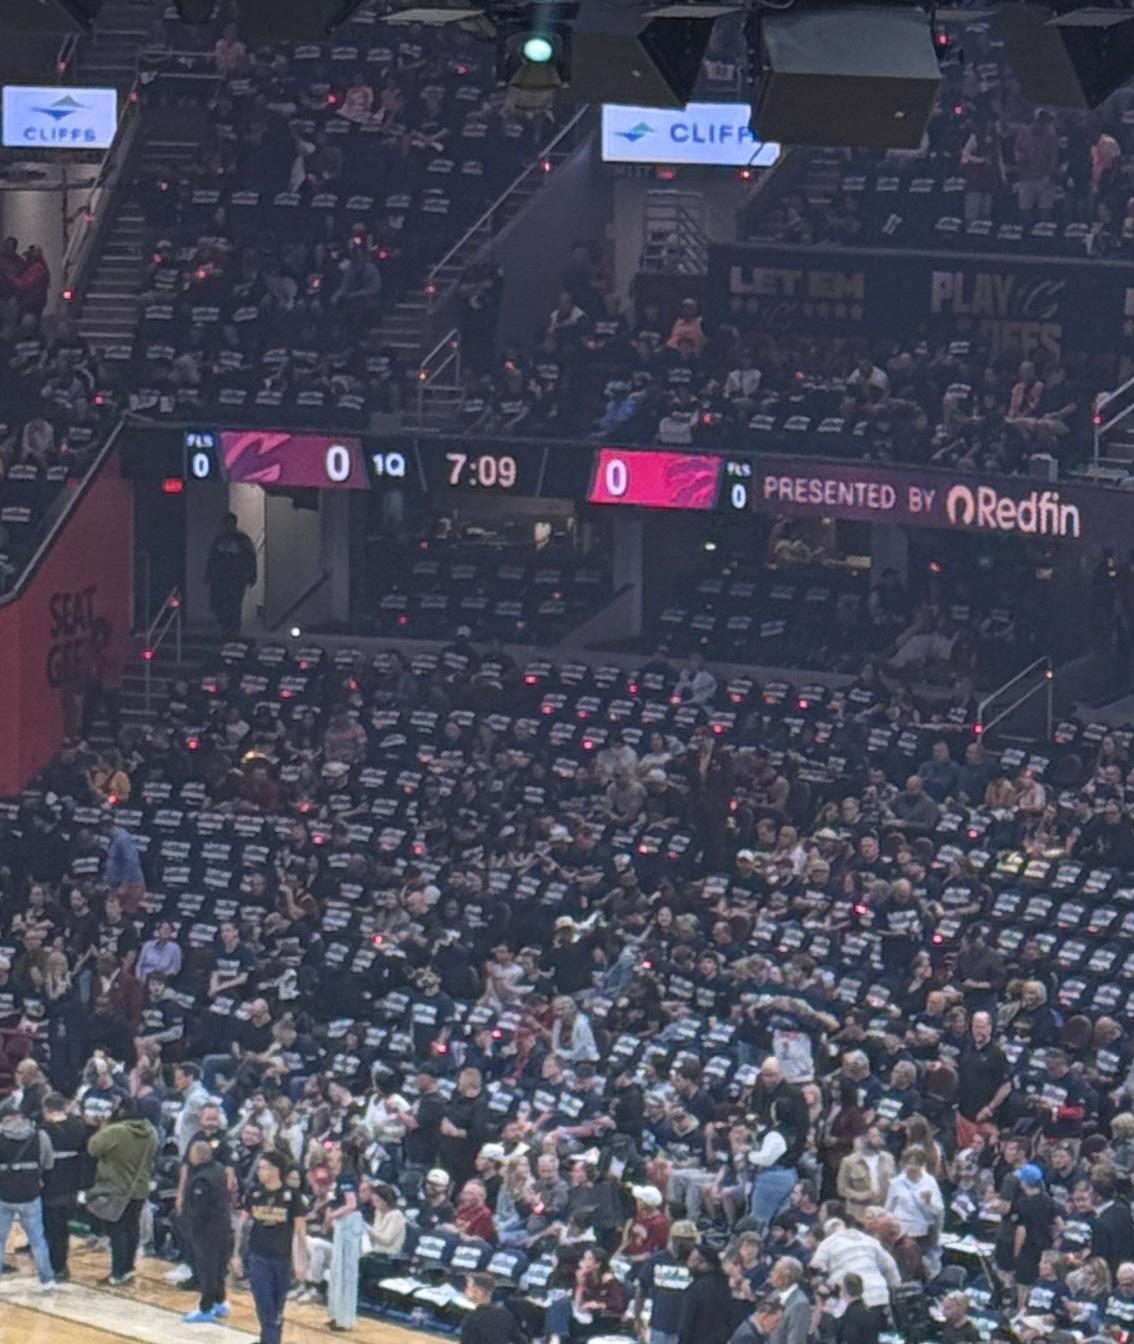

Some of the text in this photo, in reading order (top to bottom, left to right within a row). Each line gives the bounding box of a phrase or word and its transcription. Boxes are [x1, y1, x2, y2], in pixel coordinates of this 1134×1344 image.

[22, 126, 97, 143] CLIFFS
[729, 267, 865, 301] LET EM
[930, 271, 1014, 315] PLAY
[192, 452, 210, 479] 0
[325, 444, 518, 488] 0 1Q 7:09
[604, 458, 629, 496] 0
[730, 483, 747, 509] 0
[763, 475, 1081, 538] PRESENTED BY Redfin
